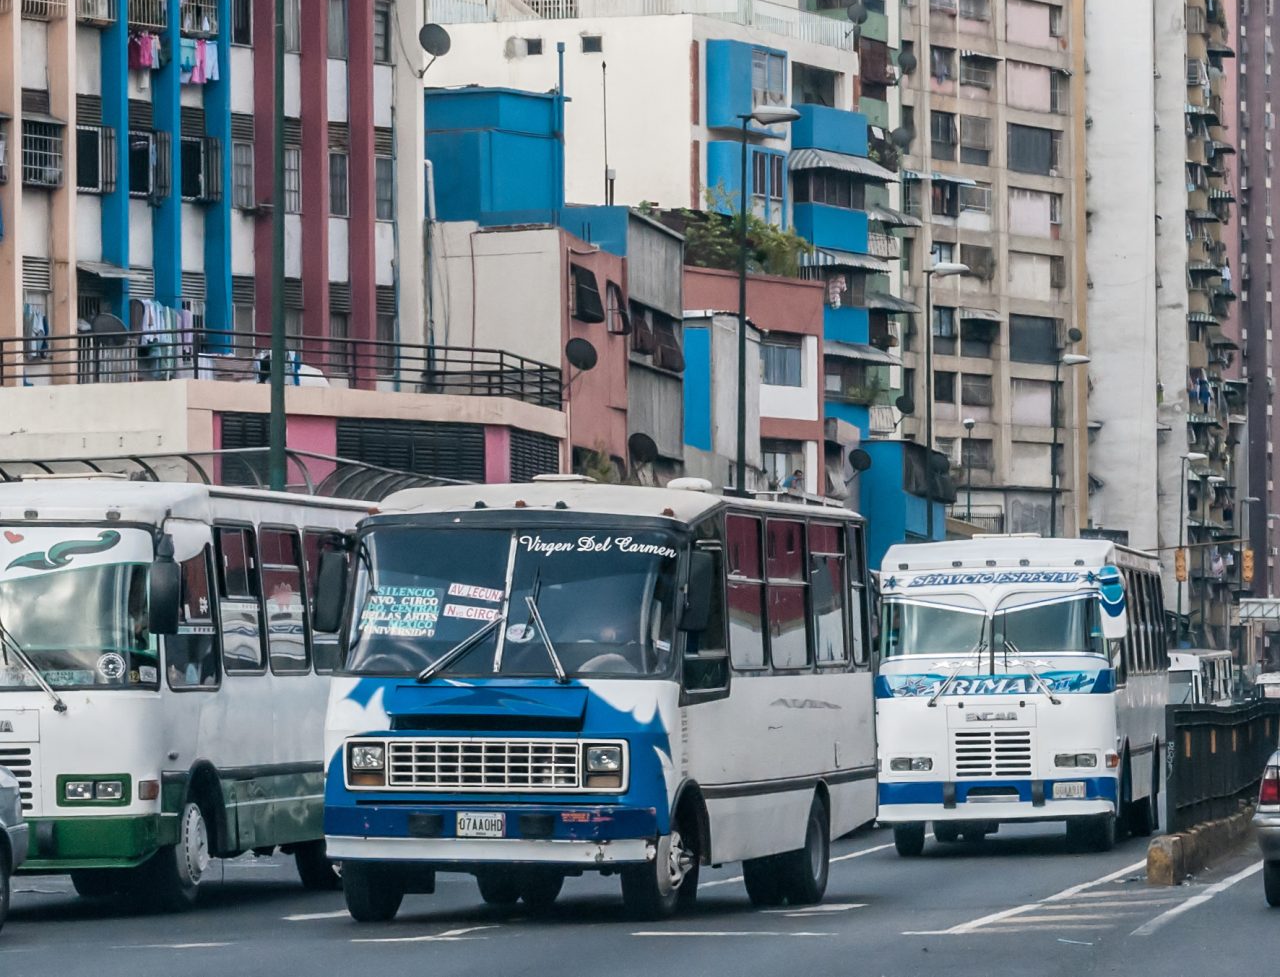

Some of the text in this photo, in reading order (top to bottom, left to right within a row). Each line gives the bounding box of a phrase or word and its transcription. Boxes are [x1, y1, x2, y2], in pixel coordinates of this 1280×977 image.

[519, 536, 677, 559] Virgen Del Carmen
[909, 572, 1080, 587] SERVICIO ESPECIAL
[377, 586, 436, 597] SILENCIO
[401, 596, 439, 606] CIRCO
